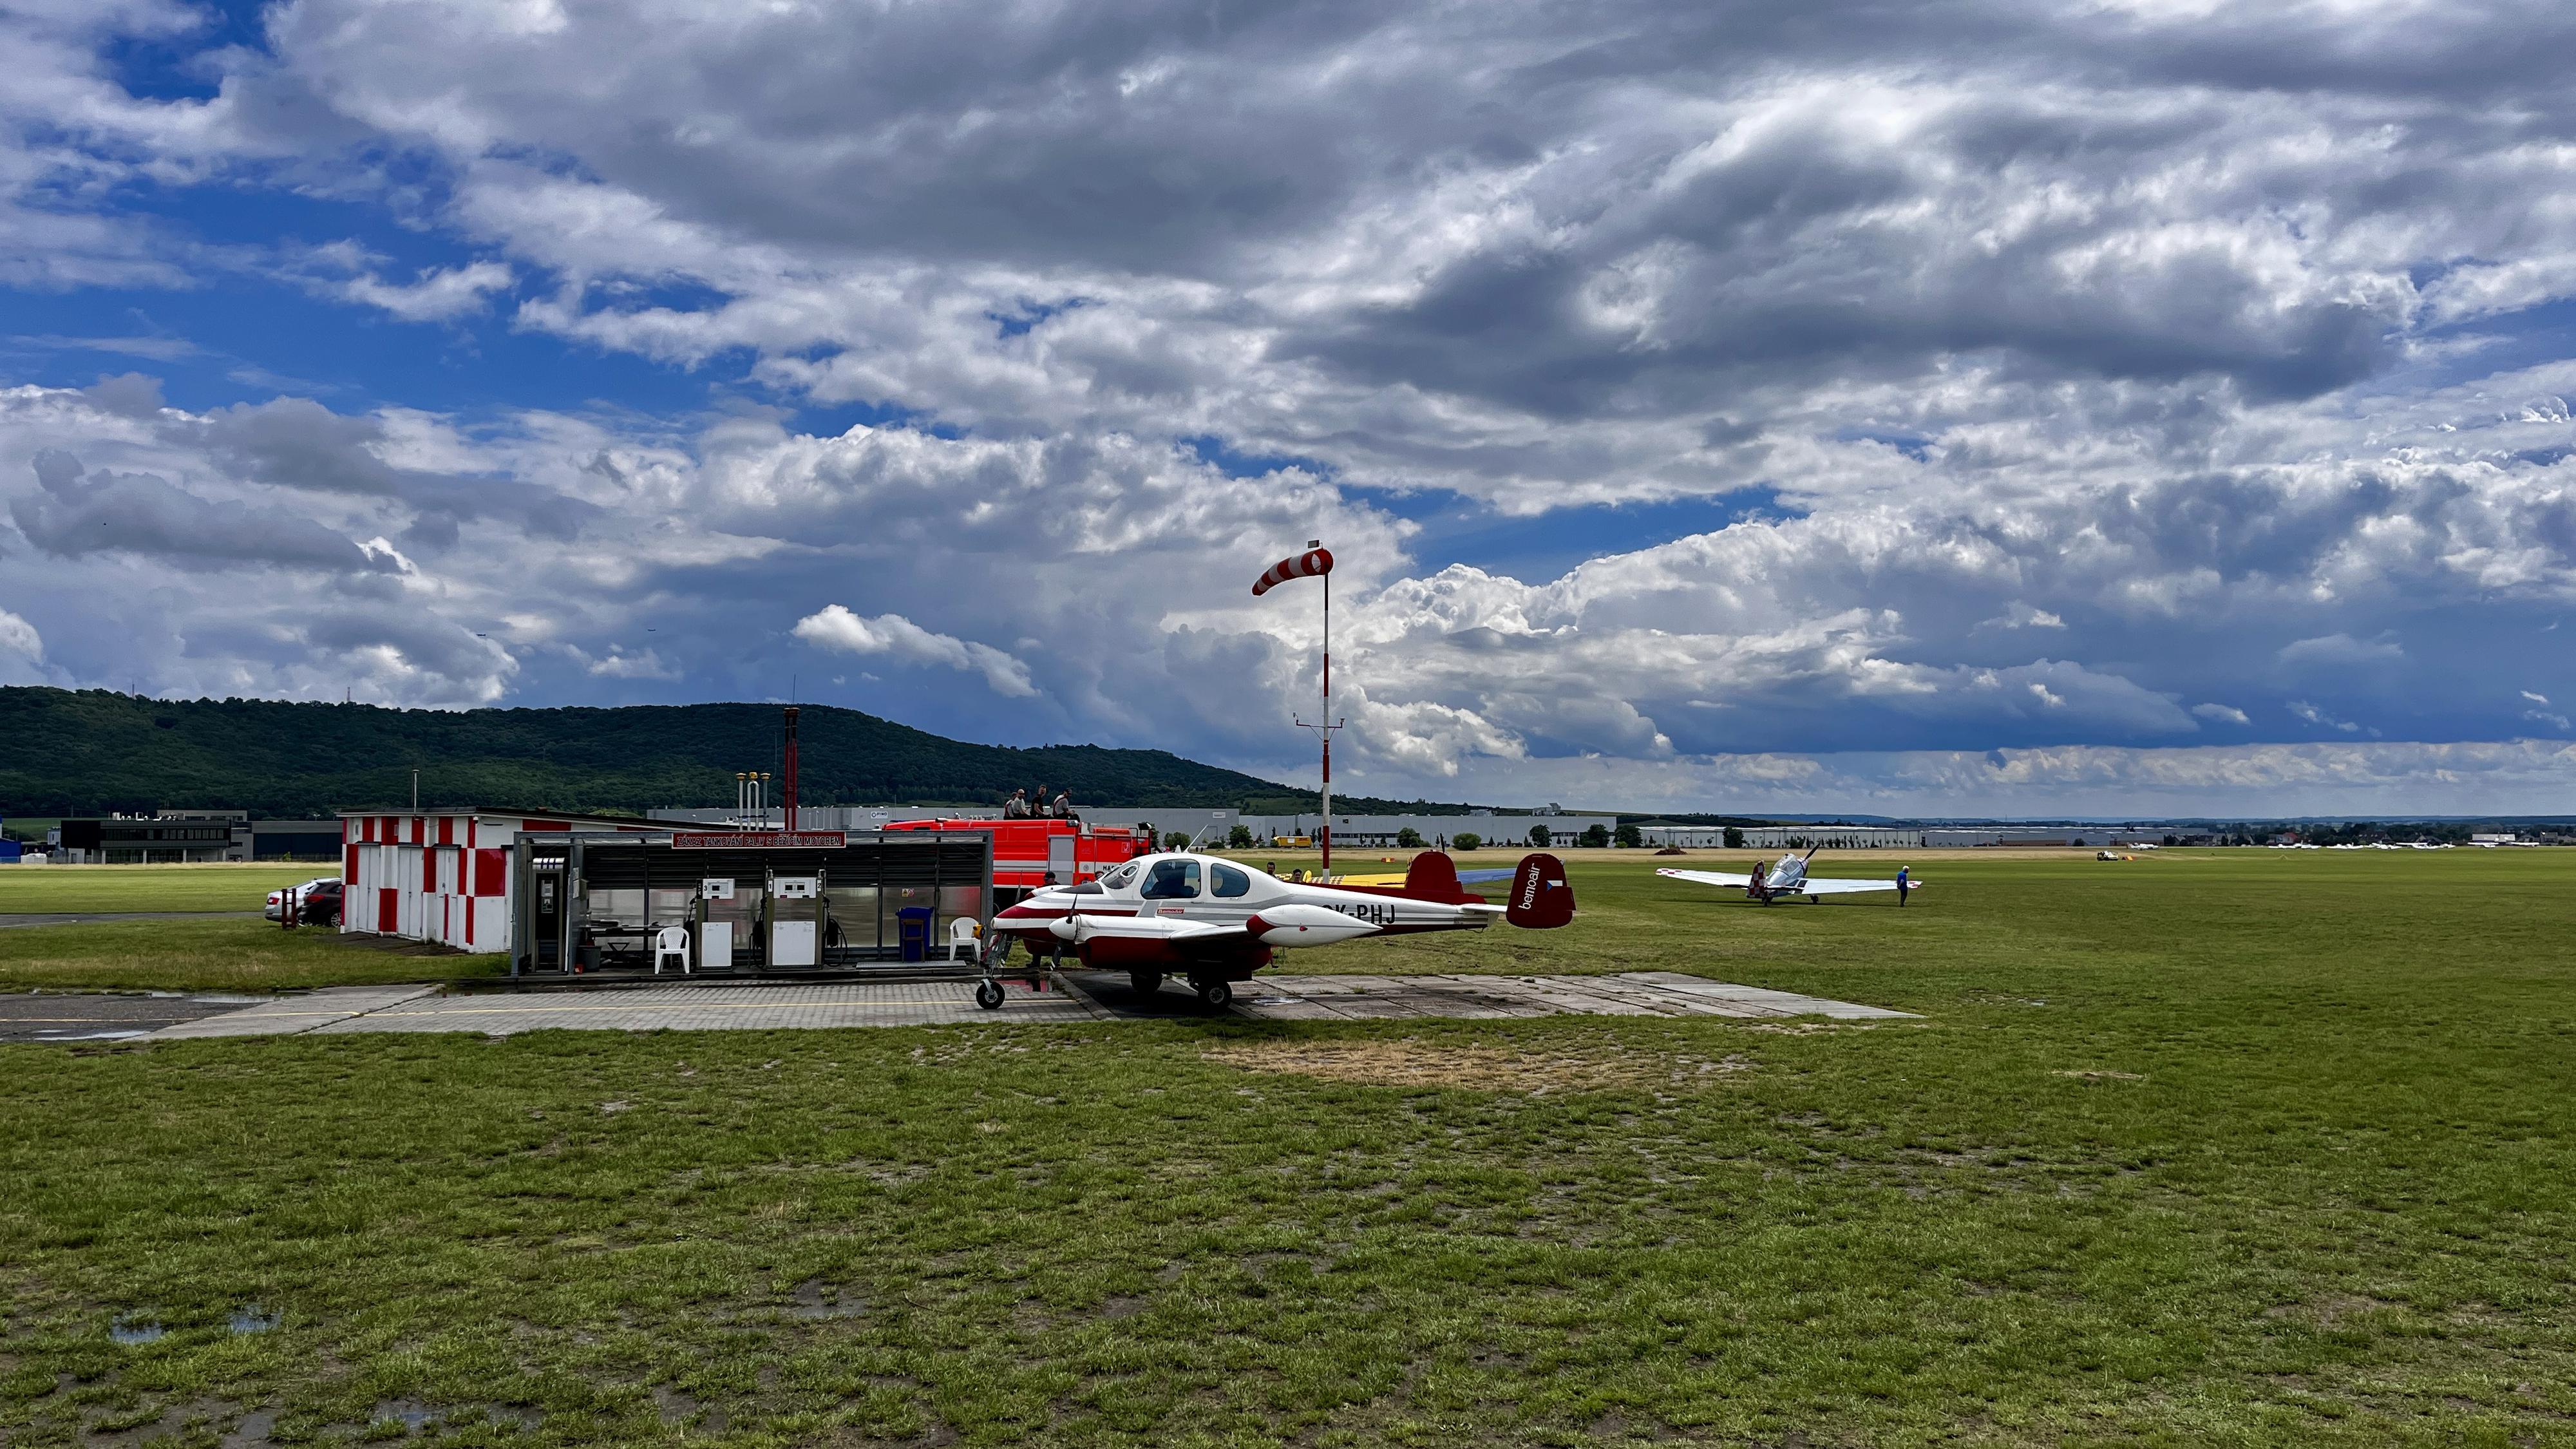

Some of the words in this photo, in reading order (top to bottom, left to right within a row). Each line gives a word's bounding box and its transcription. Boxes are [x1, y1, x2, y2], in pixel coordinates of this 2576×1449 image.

[677, 835, 701, 846] ZÁKAZ
[703, 834, 743, 846] TANKOVÁNÍ
[744, 836, 764, 846] PALIV
[766, 836, 772, 846] S
[773, 833, 802, 846] BĚŽÍCÍM
[804, 836, 841, 846] MOTOREM
[1518, 862, 1540, 910] bemoair
[1321, 904, 1396, 924] -PHJ
